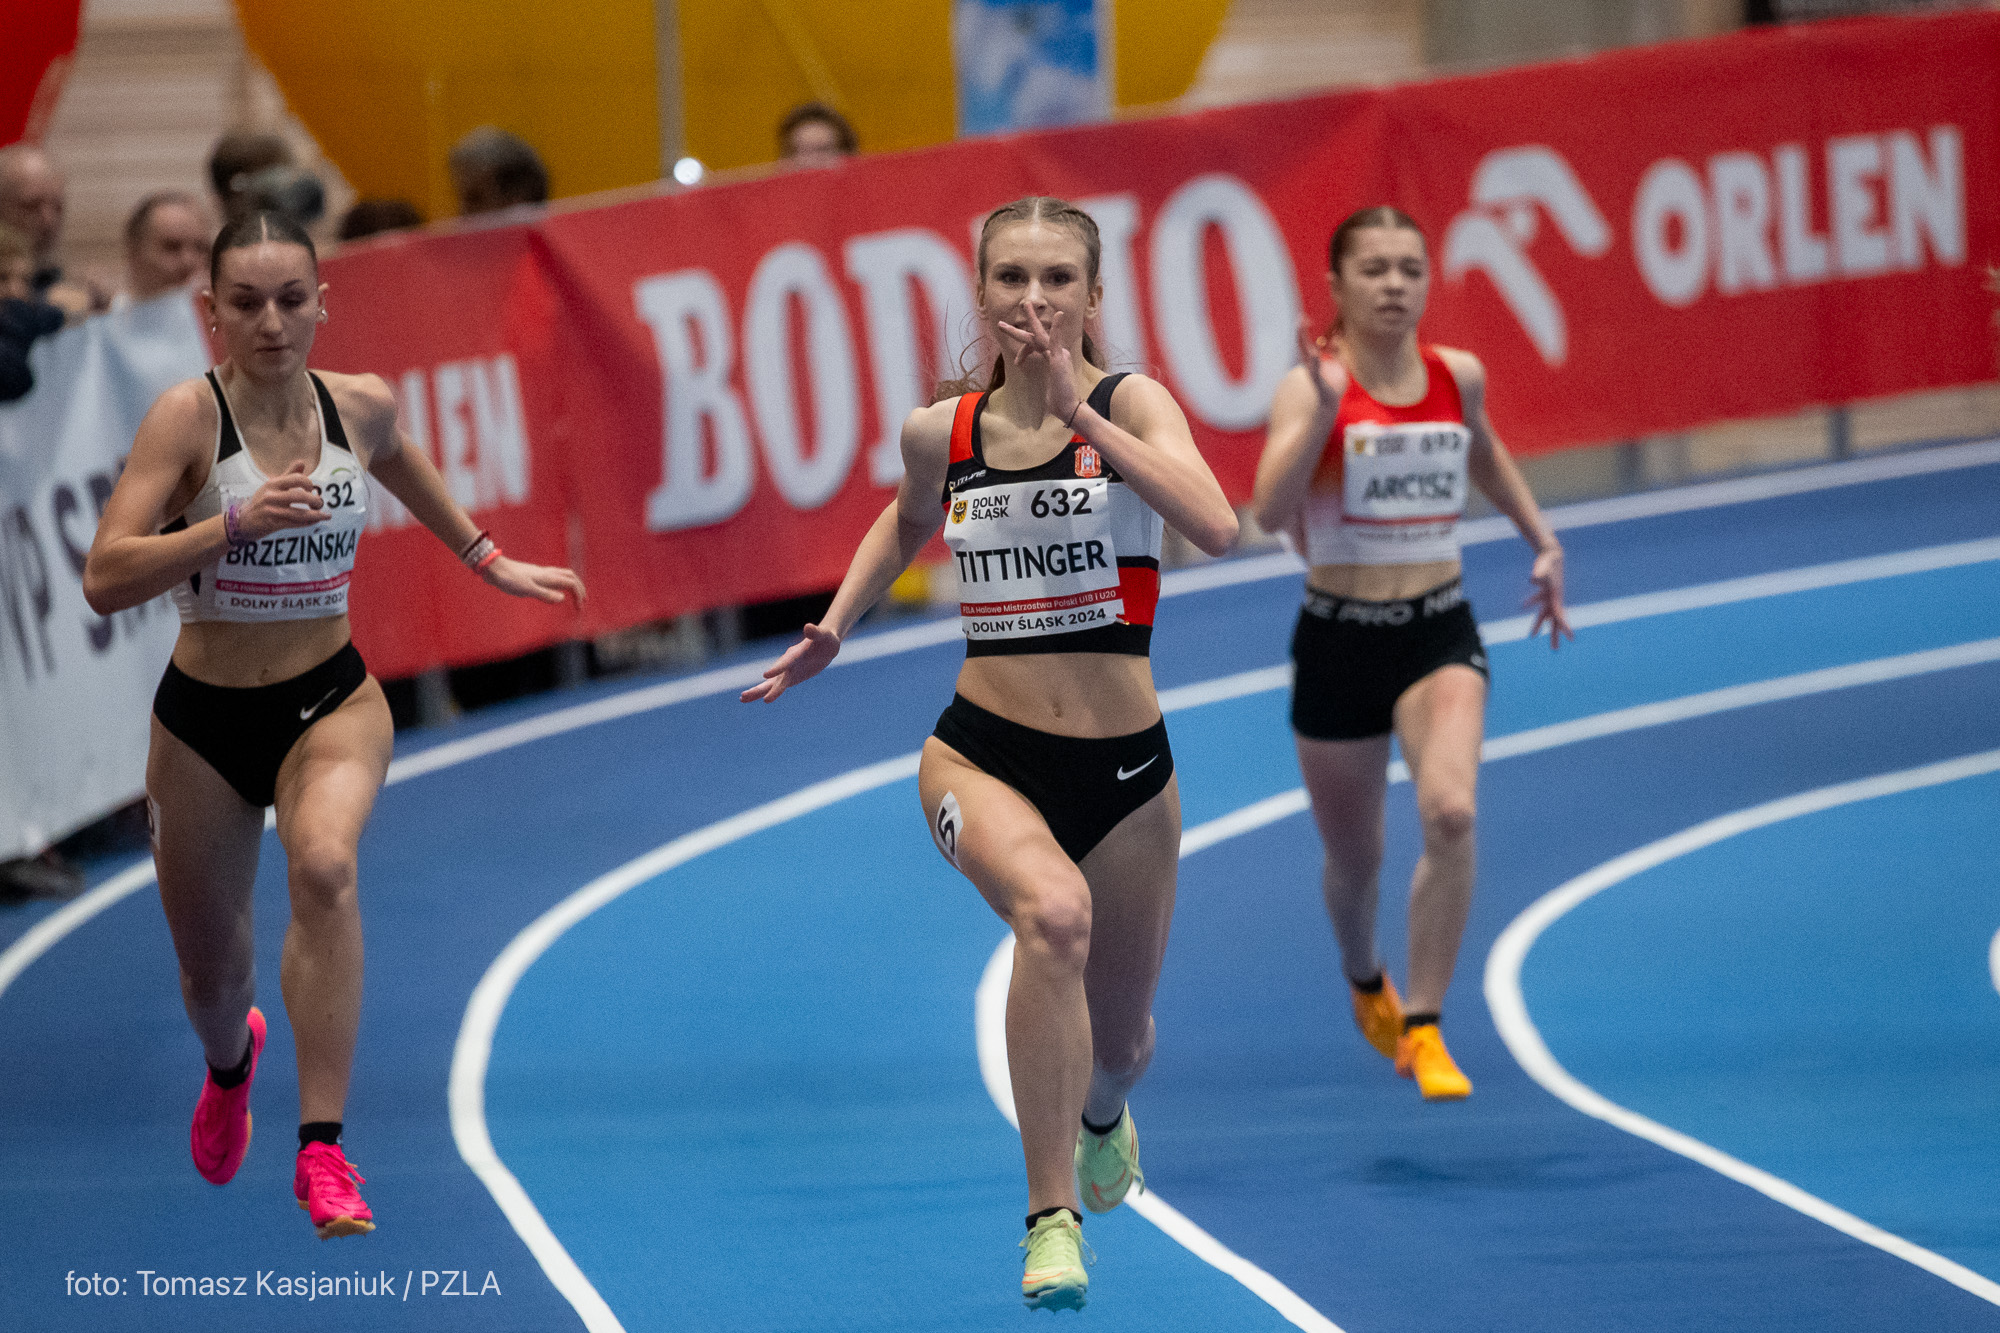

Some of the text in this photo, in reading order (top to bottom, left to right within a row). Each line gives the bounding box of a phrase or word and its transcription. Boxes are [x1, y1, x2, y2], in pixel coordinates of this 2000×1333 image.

[1632, 124, 1967, 308] ORLEN
[970, 506, 1010, 521] ŚLĄSK
[972, 494, 1011, 509] DOLNY
[1030, 487, 1093, 519] 632
[225, 527, 357, 567] BRZEZIŃSKA
[955, 539, 1109, 583] TITTINGER
[230, 596, 278, 609] DOLNY
[976, 603, 1002, 614] Halowe
[1003, 601, 1052, 613] Mistrzostwa
[1054, 597, 1078, 608] Polski
[1079, 595, 1093, 604] U18
[1099, 589, 1117, 600] U20
[972, 607, 1107, 634] DOLNY ŚLĄSK 2024
[937, 805, 957, 857] 5
